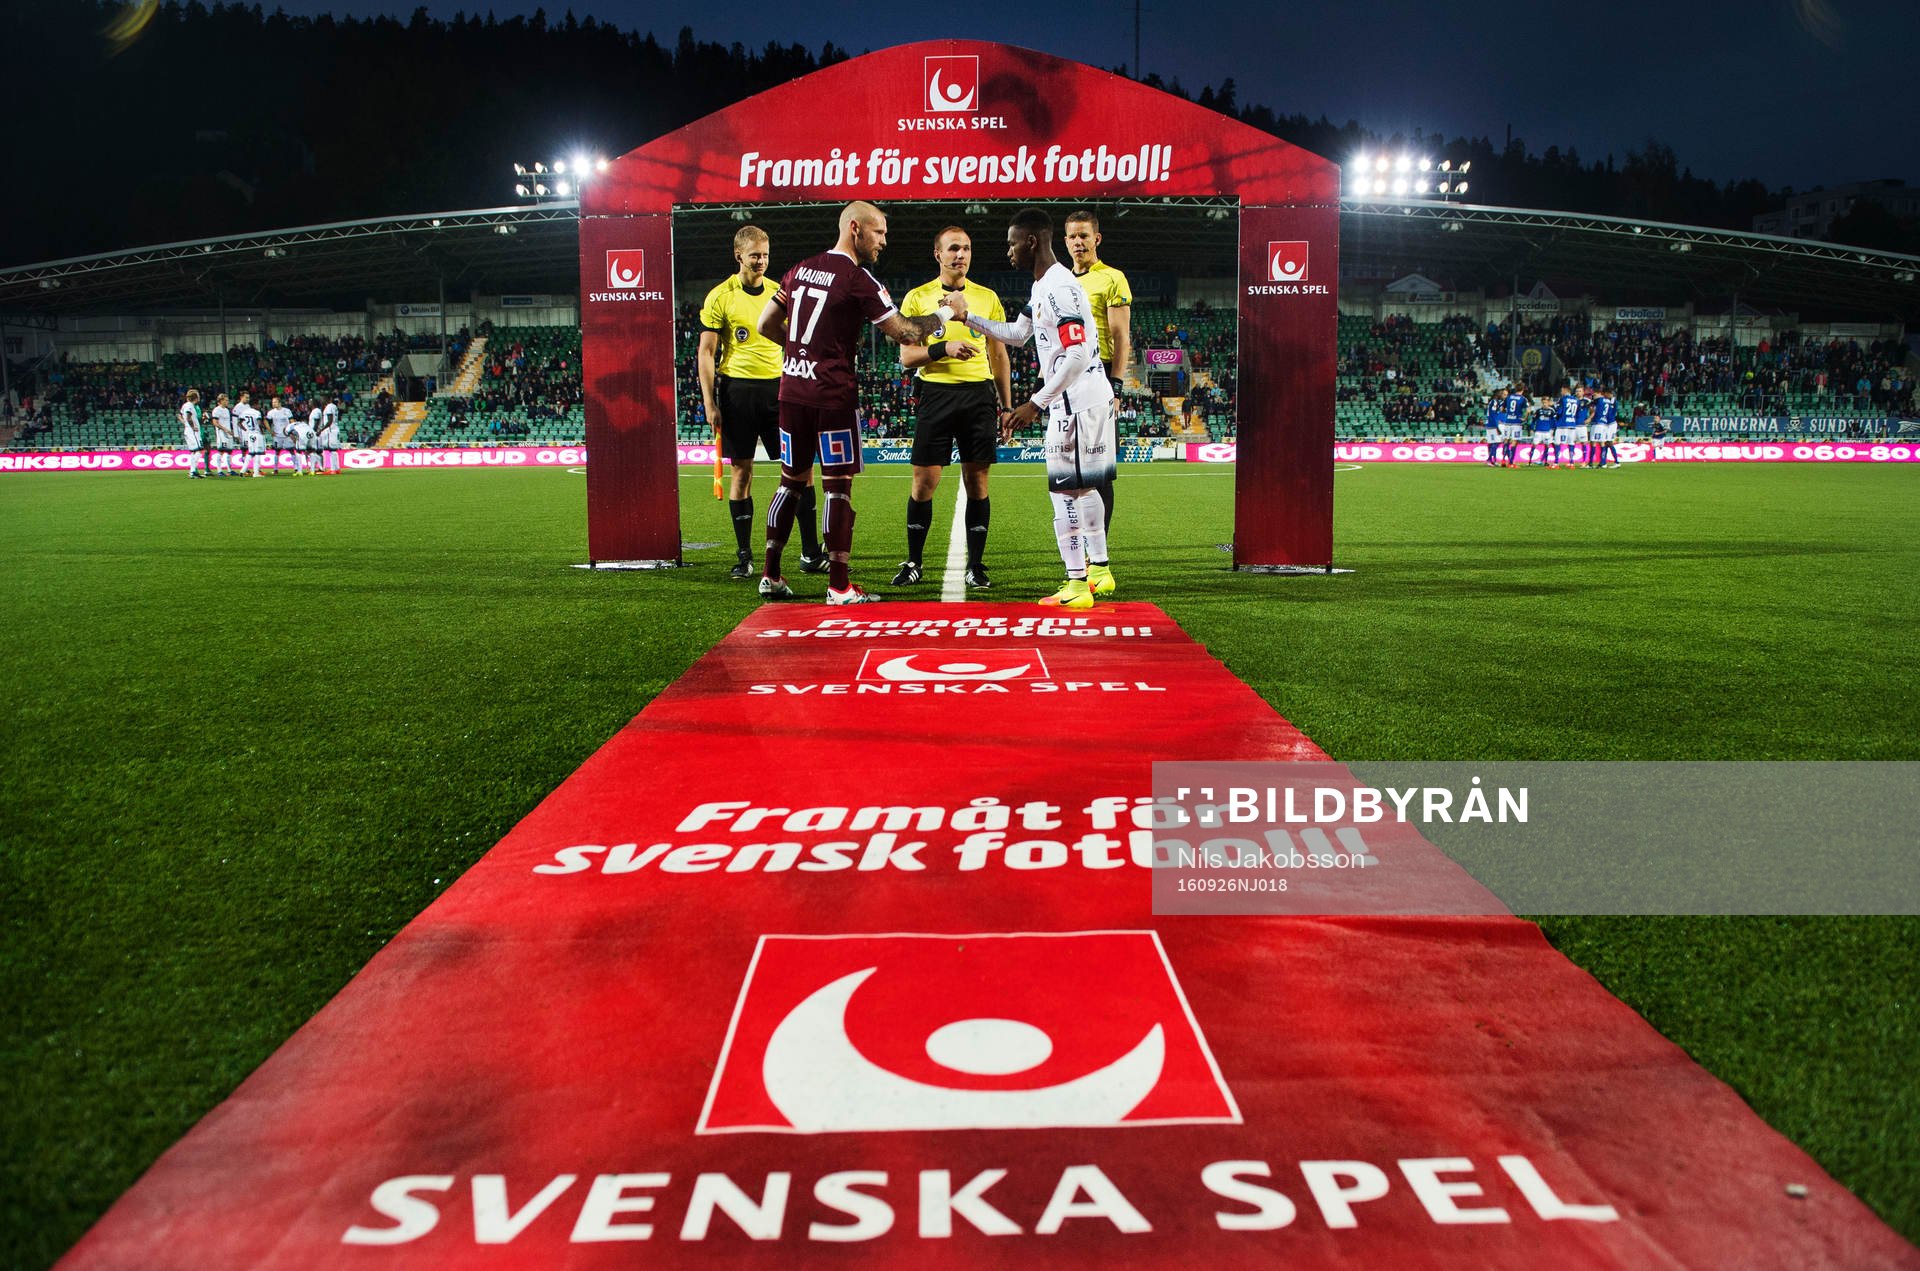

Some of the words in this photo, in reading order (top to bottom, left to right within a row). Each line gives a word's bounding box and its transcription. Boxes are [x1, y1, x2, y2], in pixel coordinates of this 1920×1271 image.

[898, 117, 966, 131] SVENSKA
[971, 116, 1007, 130] SPEL
[739, 148, 861, 188] Framåt
[867, 147, 919, 185] för
[922, 145, 1037, 184] svensk
[1043, 144, 1172, 183] fotboll!
[795, 266, 836, 287] NAURIN
[589, 292, 637, 302] SVENSKA
[639, 291, 665, 300] SPEL
[1247, 285, 1299, 295] SVENSKA
[1302, 285, 1329, 294] SPEL
[789, 285, 828, 345] 17
[1618, 308, 1665, 319] OrboTech
[1068, 324, 1083, 341] C
[1510, 400, 1516, 412] 9
[1566, 402, 1577, 417] 20
[1057, 420, 1069, 432] 12
[1683, 417, 1779, 432] PATRONERNA
[393, 452, 526, 465] RIKSBUD
[1655, 446, 1784, 460] RIKSBUD
[0, 455, 122, 470] RIKSBUD
[747, 683, 1010, 695] SVENSKA
[1030, 681, 1166, 693] SPEL
[675, 797, 1062, 832] Framåt
[532, 832, 928, 874] svensk
[340, 1164, 1153, 1245] SVENSKA
[1200, 1155, 1620, 1230] SPEL
